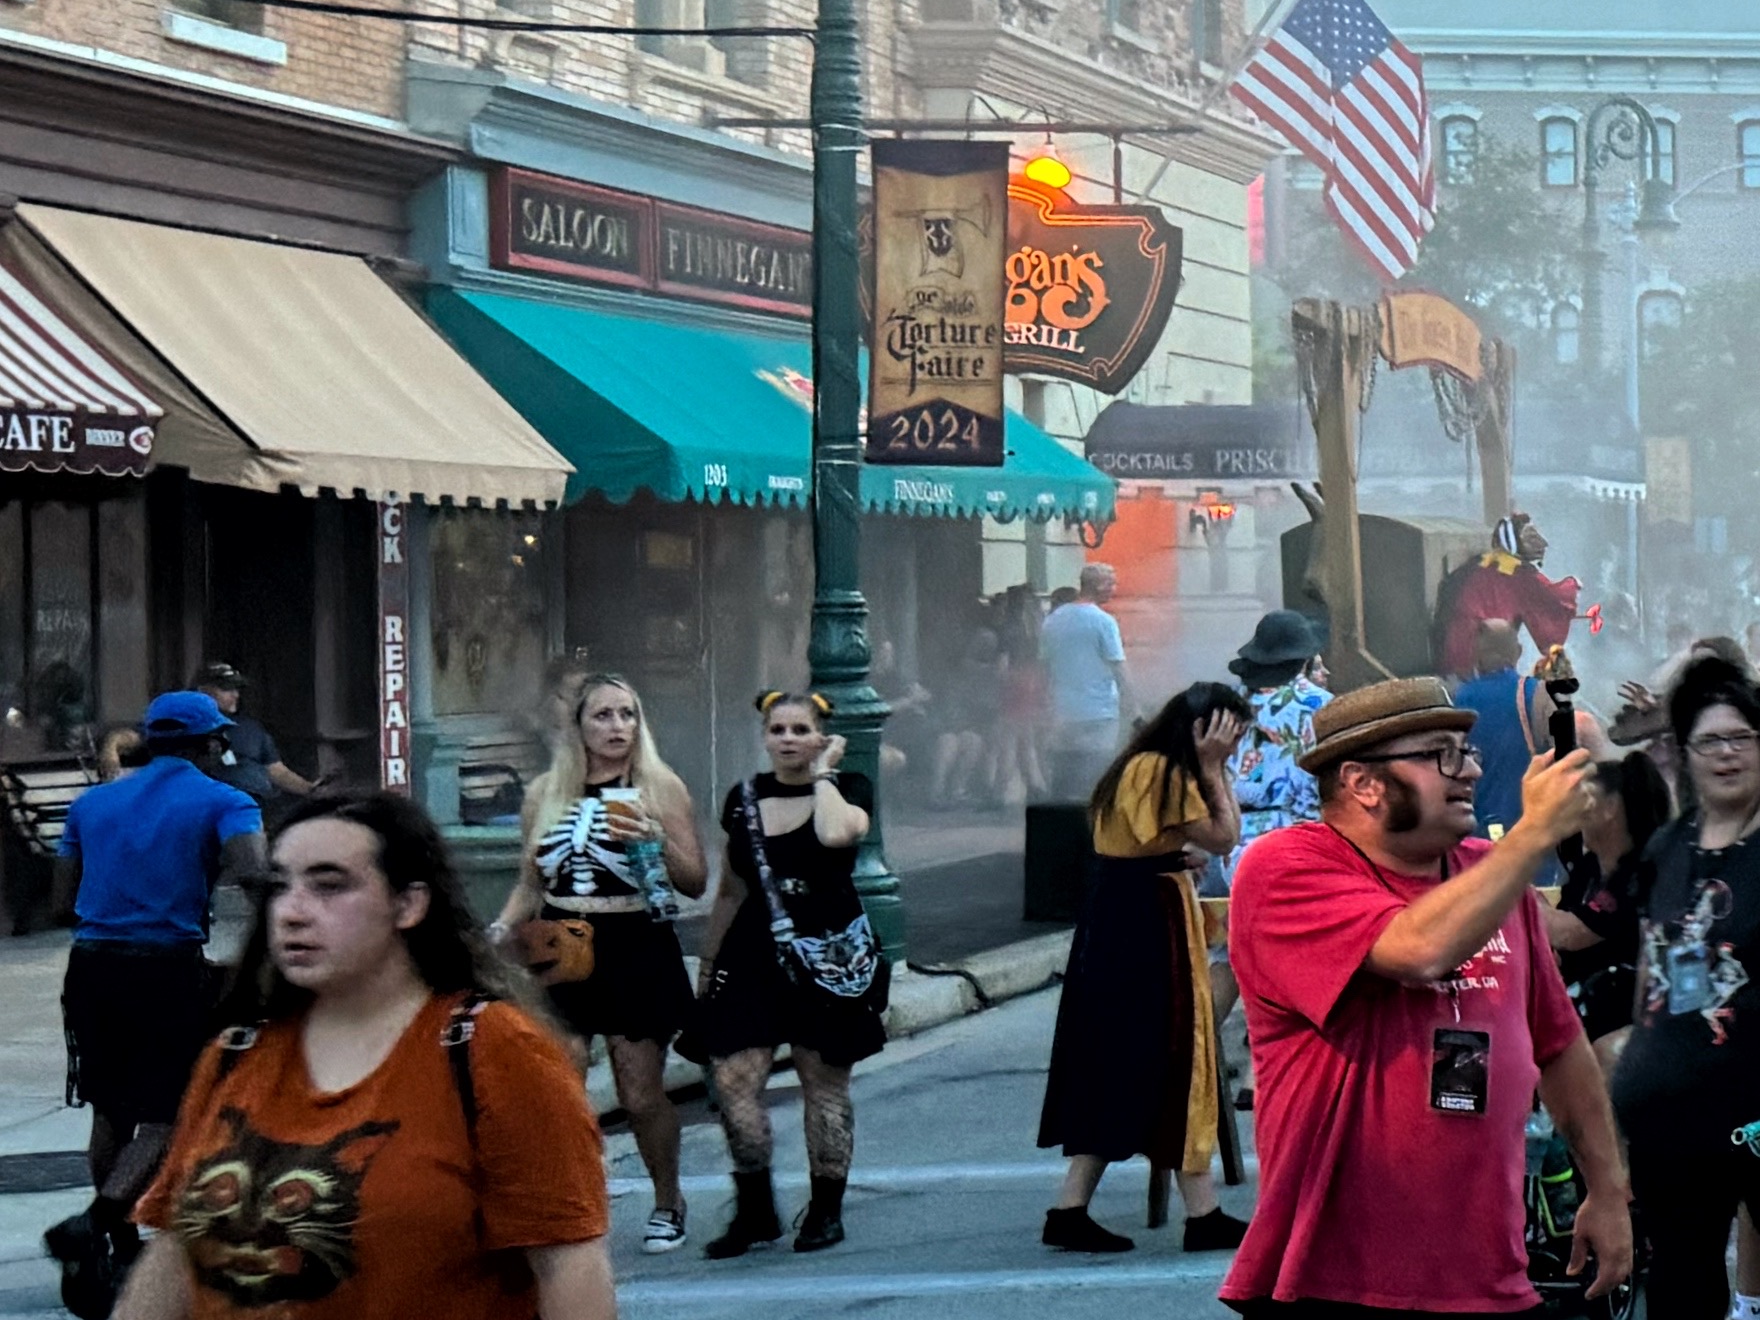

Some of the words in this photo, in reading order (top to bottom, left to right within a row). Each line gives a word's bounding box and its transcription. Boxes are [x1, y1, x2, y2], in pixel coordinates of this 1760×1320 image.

[521, 197, 628, 258] SALOON
[886, 309, 997, 362] Torture
[1003, 323, 1086, 354] GRILL
[909, 344, 984, 398] Faire
[0, 413, 76, 453] AFE
[887, 408, 981, 452] 2024
[384, 616, 407, 786] REPAIR
